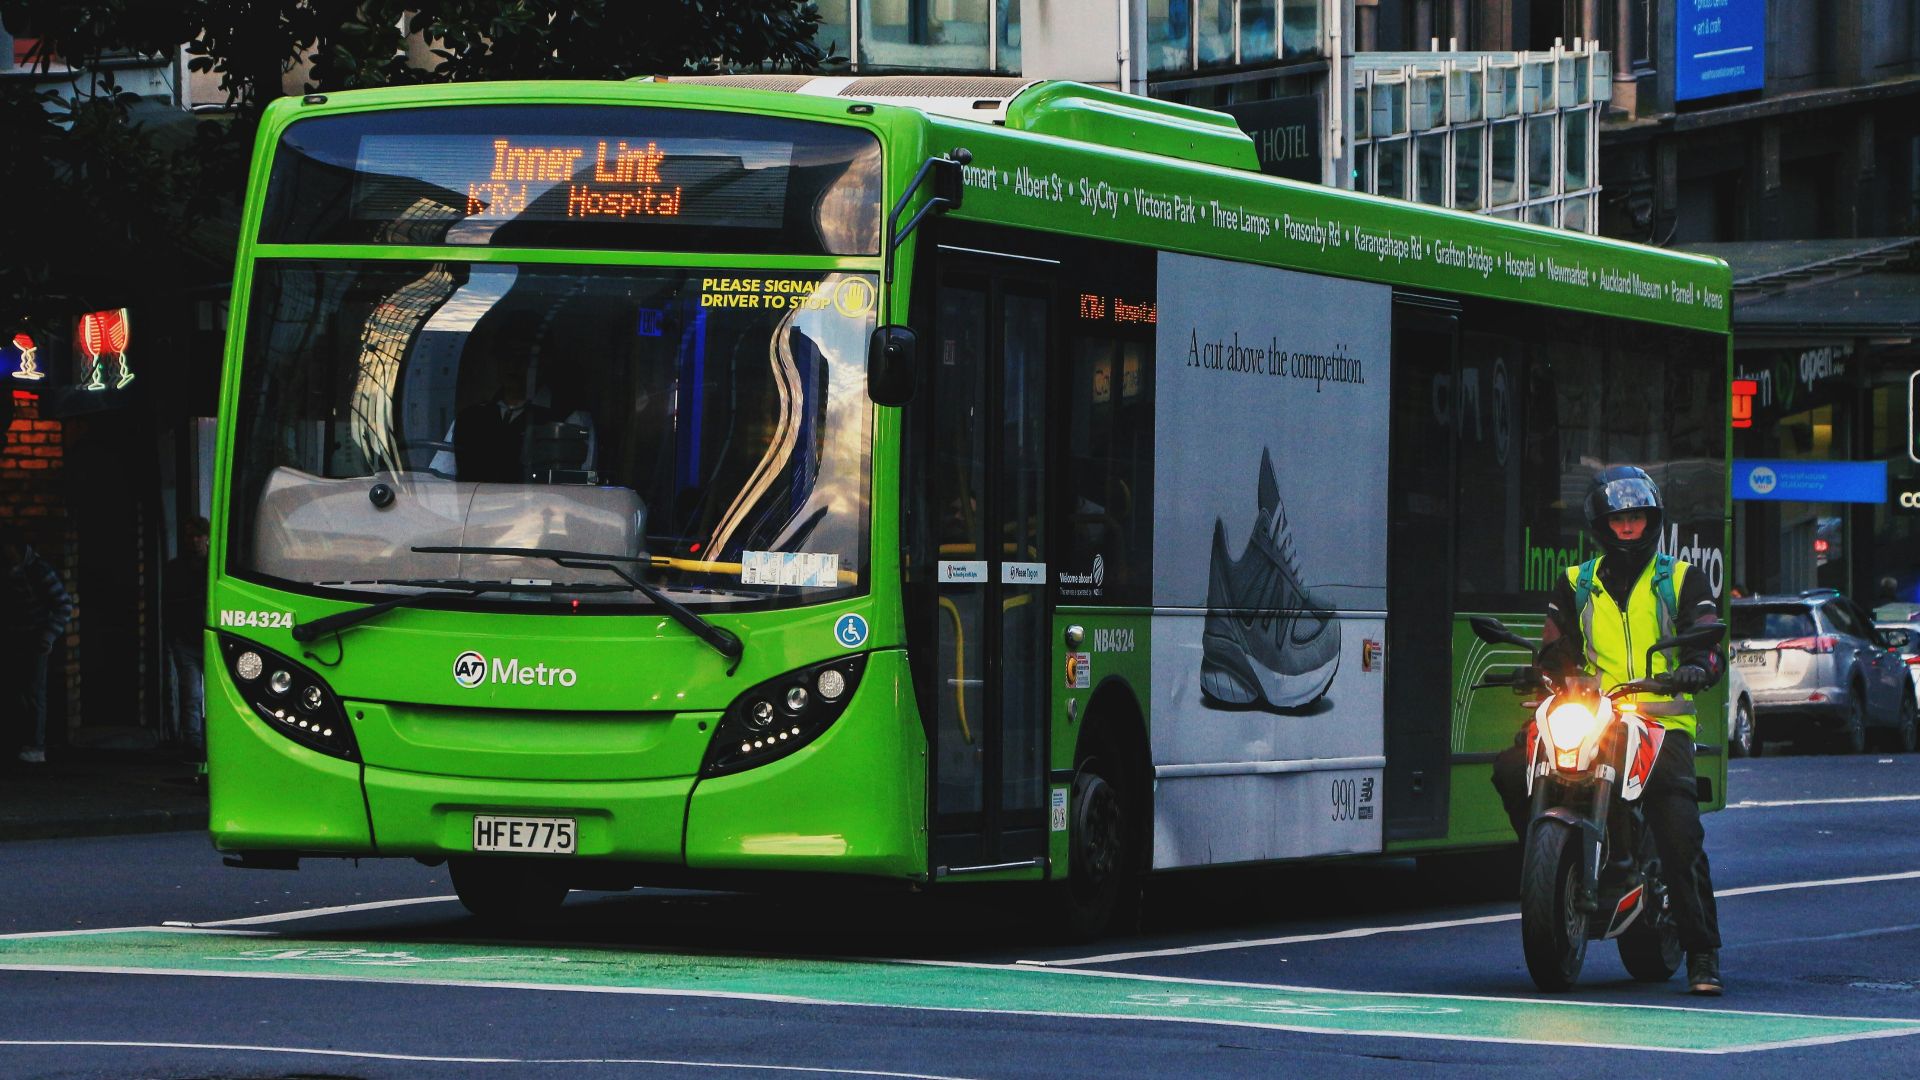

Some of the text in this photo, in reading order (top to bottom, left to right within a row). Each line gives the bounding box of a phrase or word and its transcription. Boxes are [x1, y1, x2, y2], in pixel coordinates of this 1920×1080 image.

[1263, 124, 1309, 162] HOTEL
[491, 140, 665, 183] Inner Link
[568, 185, 682, 218] Hospital
[1015, 166, 1049, 200] Albert
[1051, 173, 1063, 202] St
[1079, 177, 1119, 219] SkyCity
[1133, 187, 1172, 221] Victoria
[1174, 195, 1196, 224] Park
[1210, 200, 1238, 230] Three
[1240, 205, 1270, 242] Lamps
[1284, 213, 1327, 252] Ponsonby
[1328, 220, 1341, 247] Rd
[1354, 225, 1409, 264] Karangahape
[1411, 235, 1422, 261] Rd
[1435, 239, 1465, 268] Grafton
[1467, 245, 1493, 278] Bridge
[1505, 251, 1536, 283] Hospital
[1547, 257, 1589, 287] Newmarket
[1600, 267, 1631, 294] Auckland
[1632, 272, 1662, 300] Museum
[1671, 280, 1694, 305] Parnell
[1703, 286, 1723, 309] Arena
[702, 278, 760, 293] PLEASE
[701, 293, 831, 310] DRIVER TO STOP
[1187, 327, 1365, 393] A cut above the competition.
[1800, 347, 1832, 392] open
[1016, 568, 1026, 577] Please
[1059, 572, 1093, 584] Welcome aboard
[220, 609, 292, 628] NB4324
[1094, 628, 1135, 652] NB4324
[491, 658, 577, 687] Metro
[1332, 779, 1355, 821] 990
[477, 821, 571, 848] HFE775
